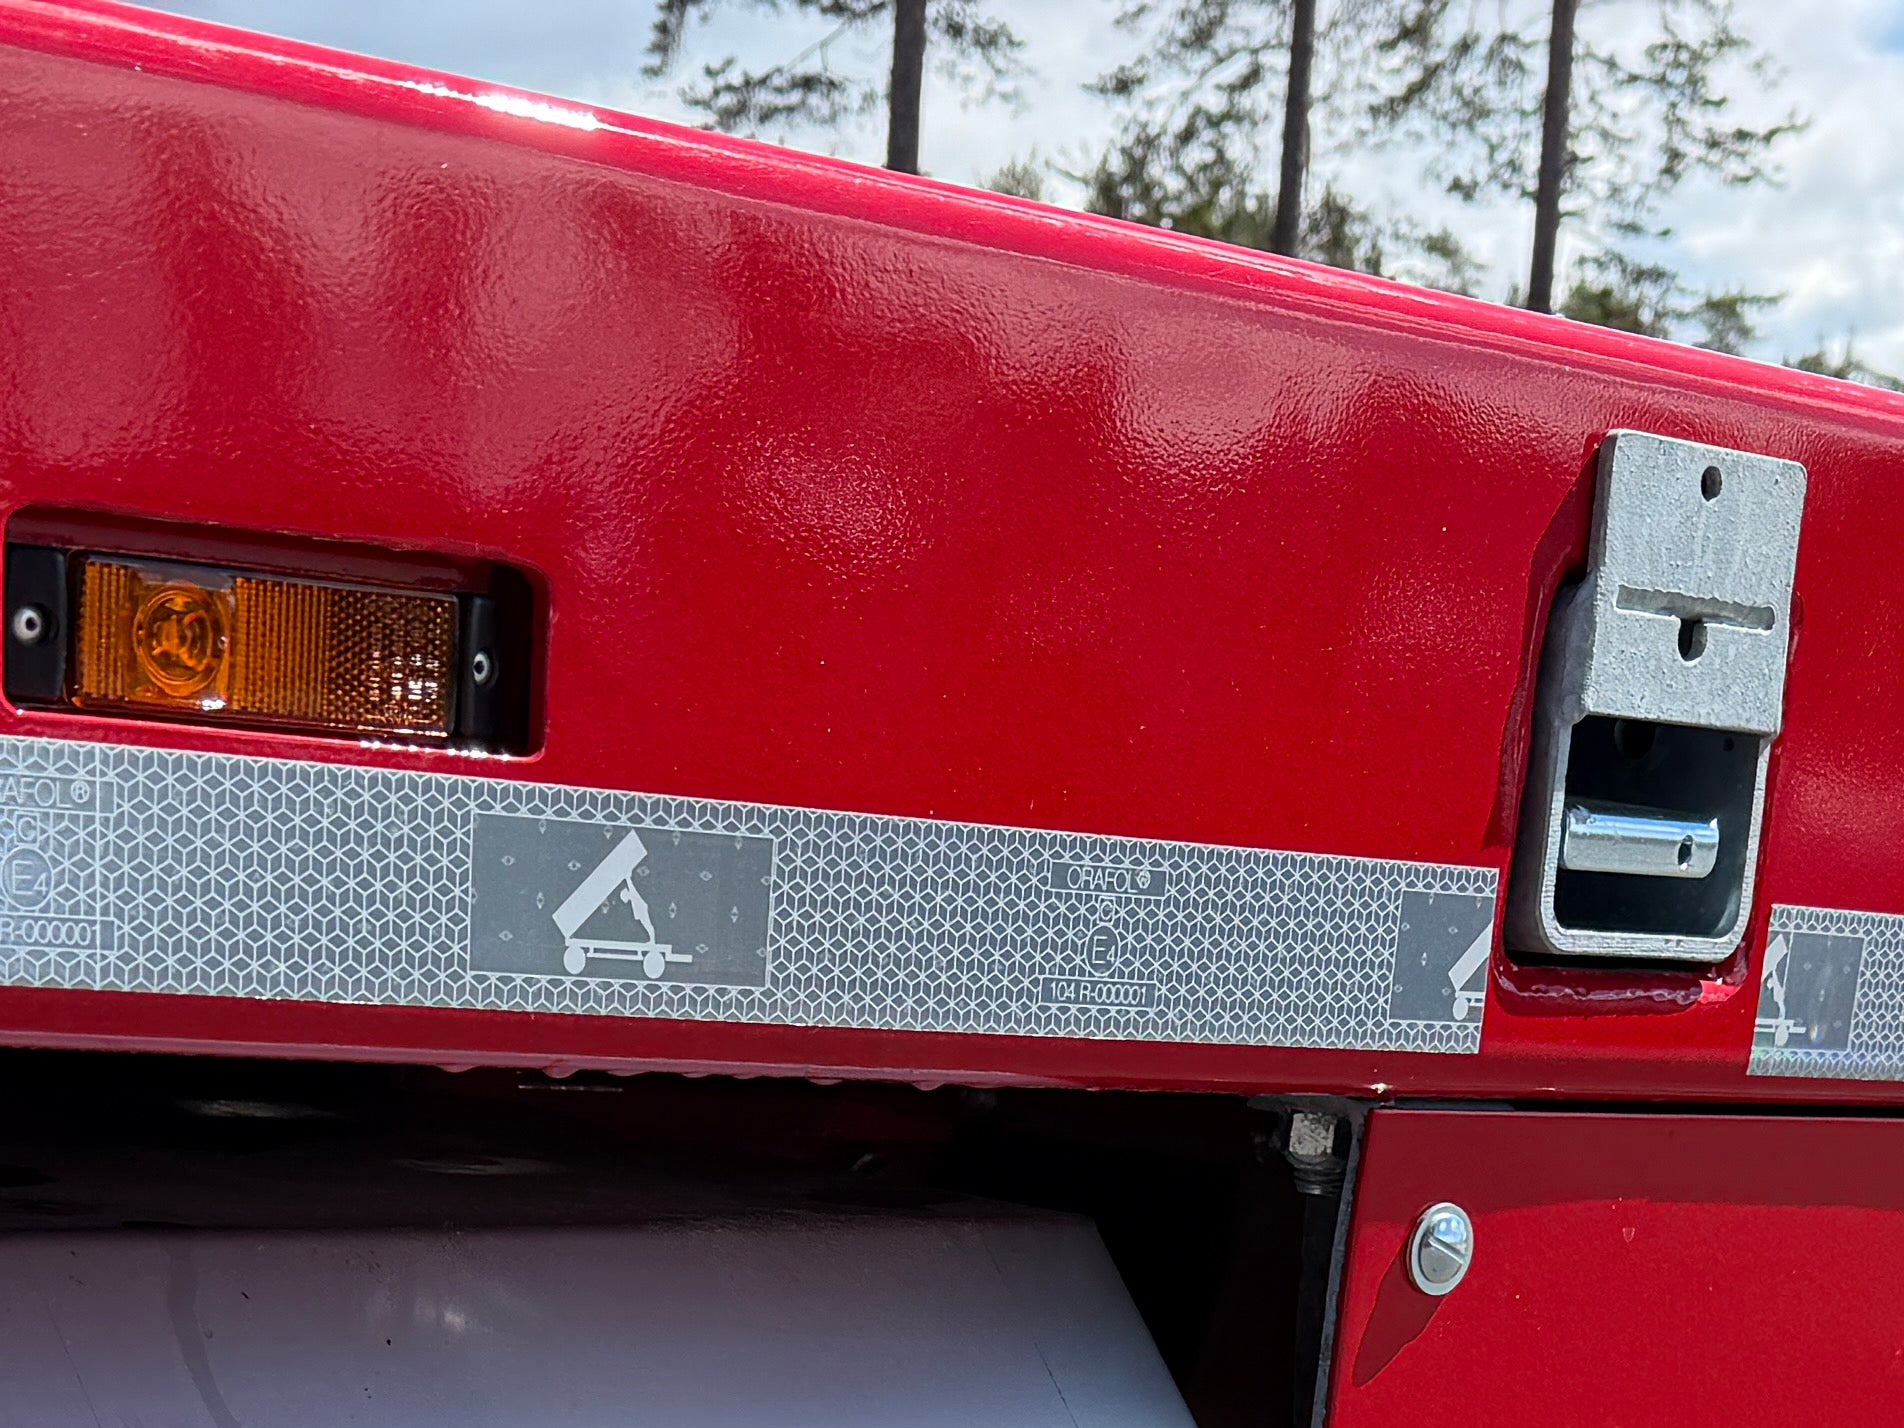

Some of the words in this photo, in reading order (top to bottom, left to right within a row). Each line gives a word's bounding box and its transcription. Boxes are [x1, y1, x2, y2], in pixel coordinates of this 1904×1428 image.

[11, 859, 49, 896] E4
[1091, 935, 1116, 965] E4
[1049, 980, 1076, 1002] 104
[1079, 981, 1148, 1006] R-000001
